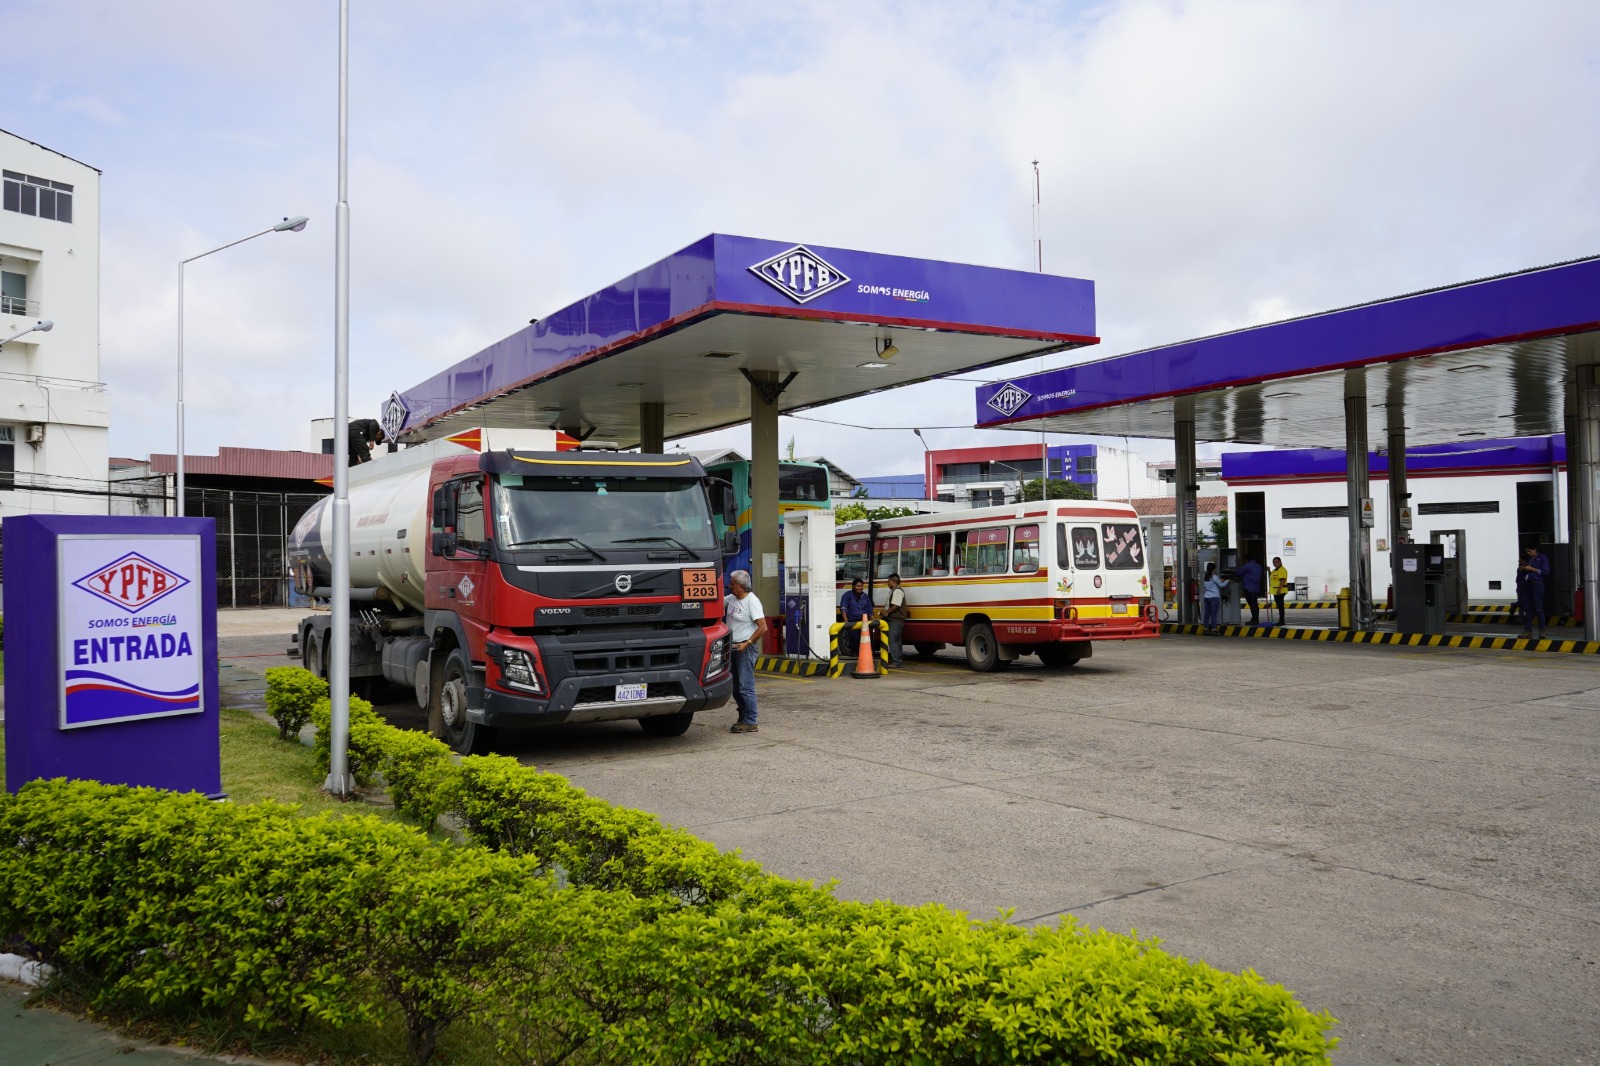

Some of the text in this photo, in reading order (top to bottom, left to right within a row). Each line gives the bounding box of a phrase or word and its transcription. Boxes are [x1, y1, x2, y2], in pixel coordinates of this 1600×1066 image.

[771, 255, 830, 292] YPFB
[892, 288, 930, 300] ENERGÍA
[995, 389, 1022, 409] YPFB
[98, 563, 168, 600] YPFB
[692, 573, 707, 583] 33
[686, 587, 715, 597] 1203
[88, 614, 177, 629] SOMOS ENERGÍA
[73, 631, 193, 666] ENTRADA
